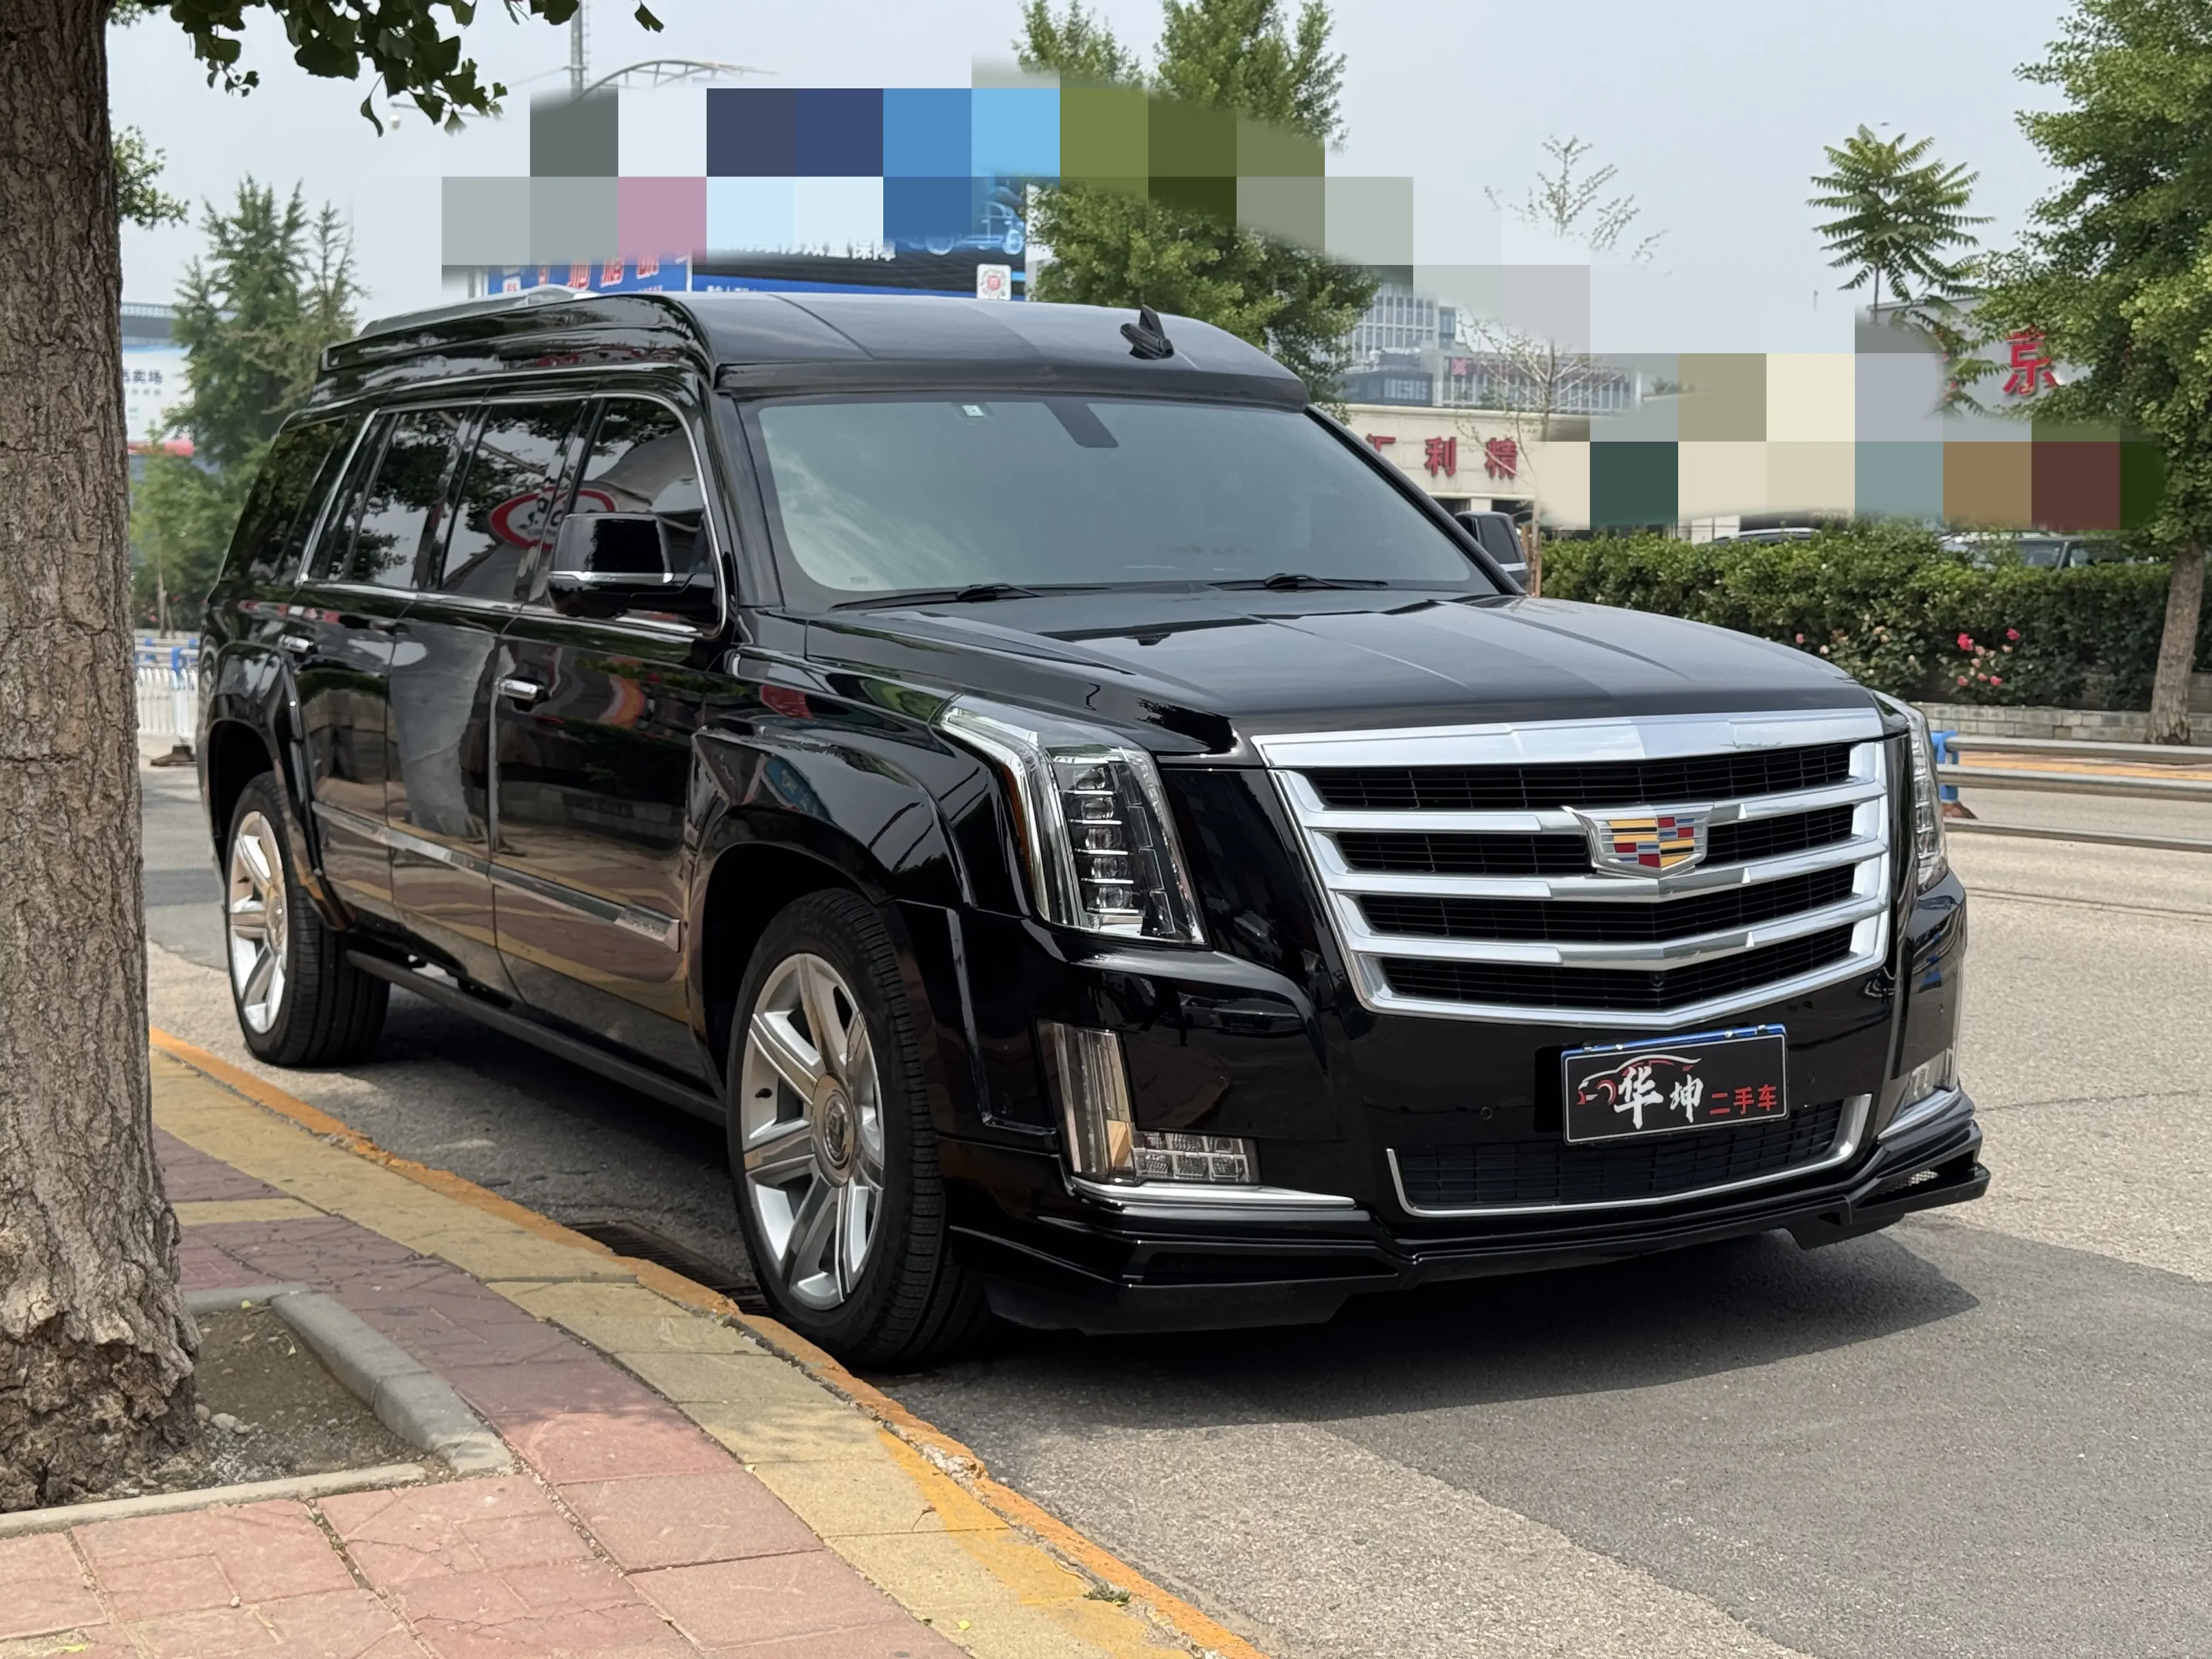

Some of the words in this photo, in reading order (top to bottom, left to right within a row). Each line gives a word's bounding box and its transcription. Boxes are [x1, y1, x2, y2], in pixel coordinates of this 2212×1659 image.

[2003, 326, 2057, 395] 京
[1614, 1066, 1703, 1129] 华坤
[1710, 1085, 1777, 1114] 二手车
